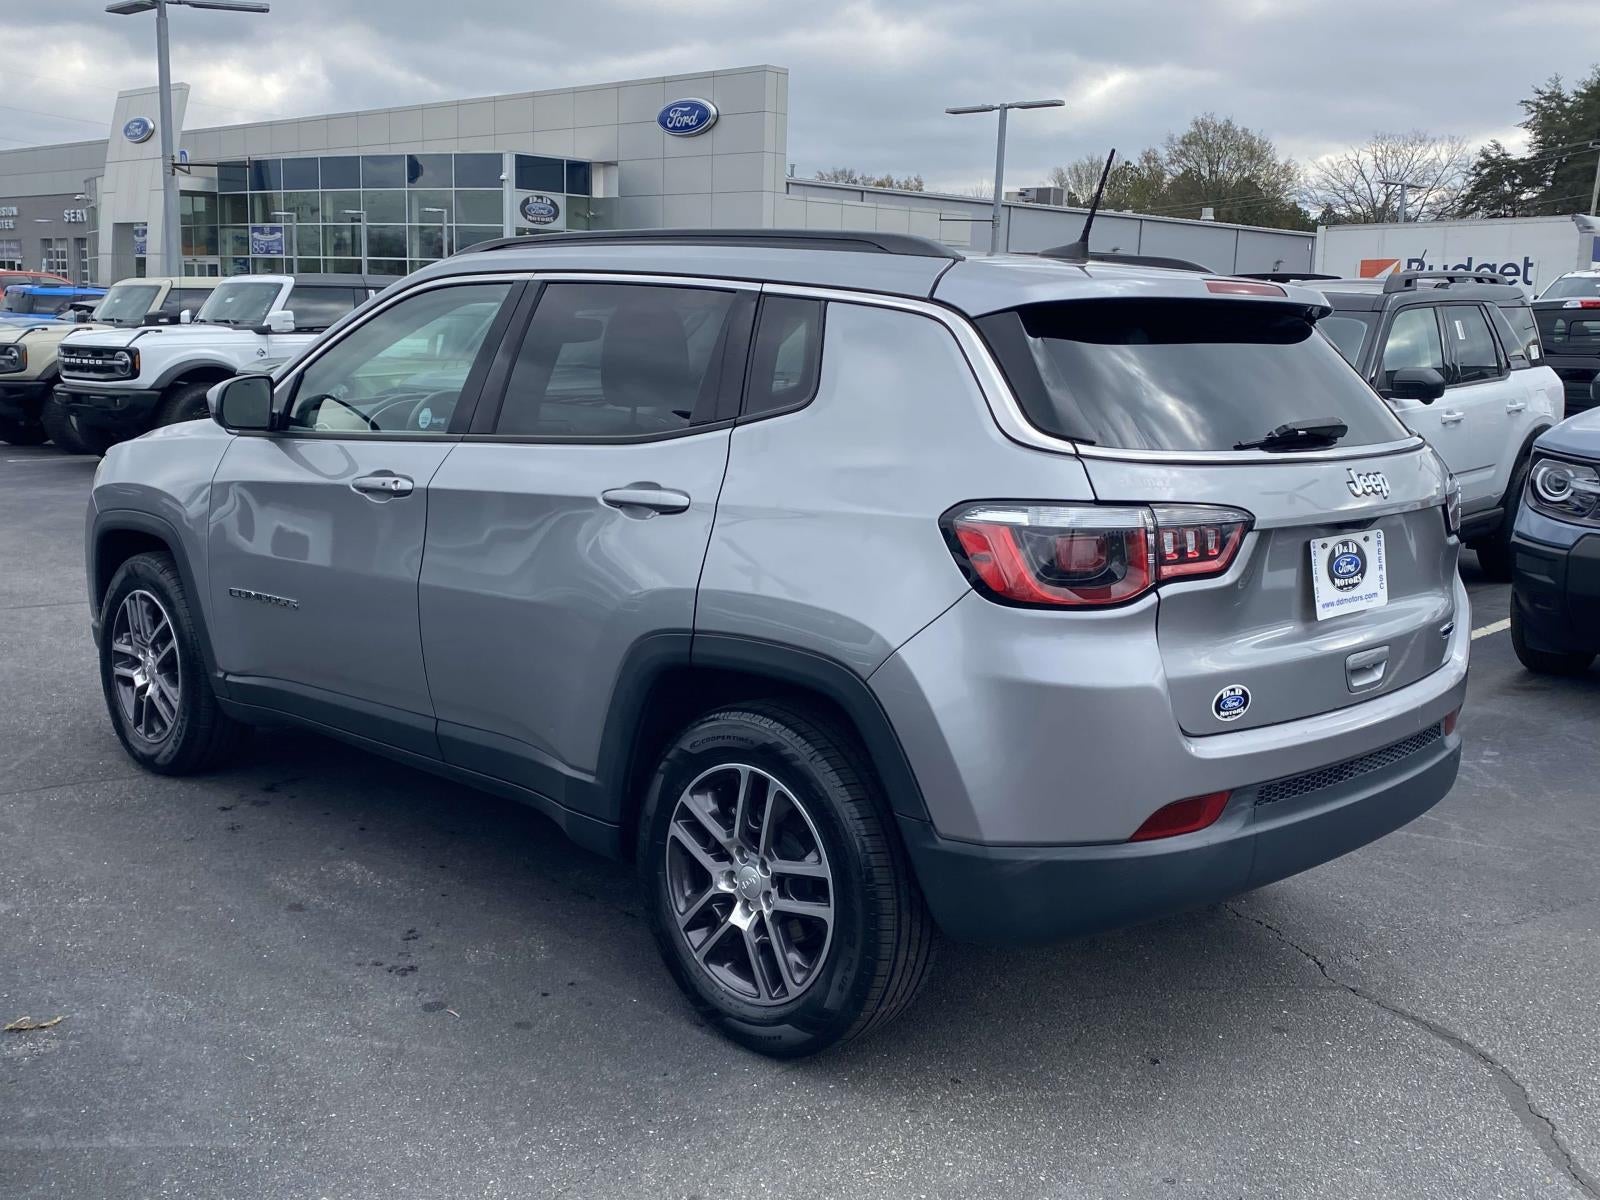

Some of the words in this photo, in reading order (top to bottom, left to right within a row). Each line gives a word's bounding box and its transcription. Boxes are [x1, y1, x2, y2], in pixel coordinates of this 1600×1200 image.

[666, 106, 699, 128] Ford
[1346, 467, 1391, 500] Jeep
[1335, 541, 1358, 558] D&D
[1338, 557, 1356, 574] Ford
[1334, 573, 1362, 588] MOTORS
[1321, 591, 1378, 609] www.ddmotors.com
[1219, 706, 1244, 717] MOTORS
